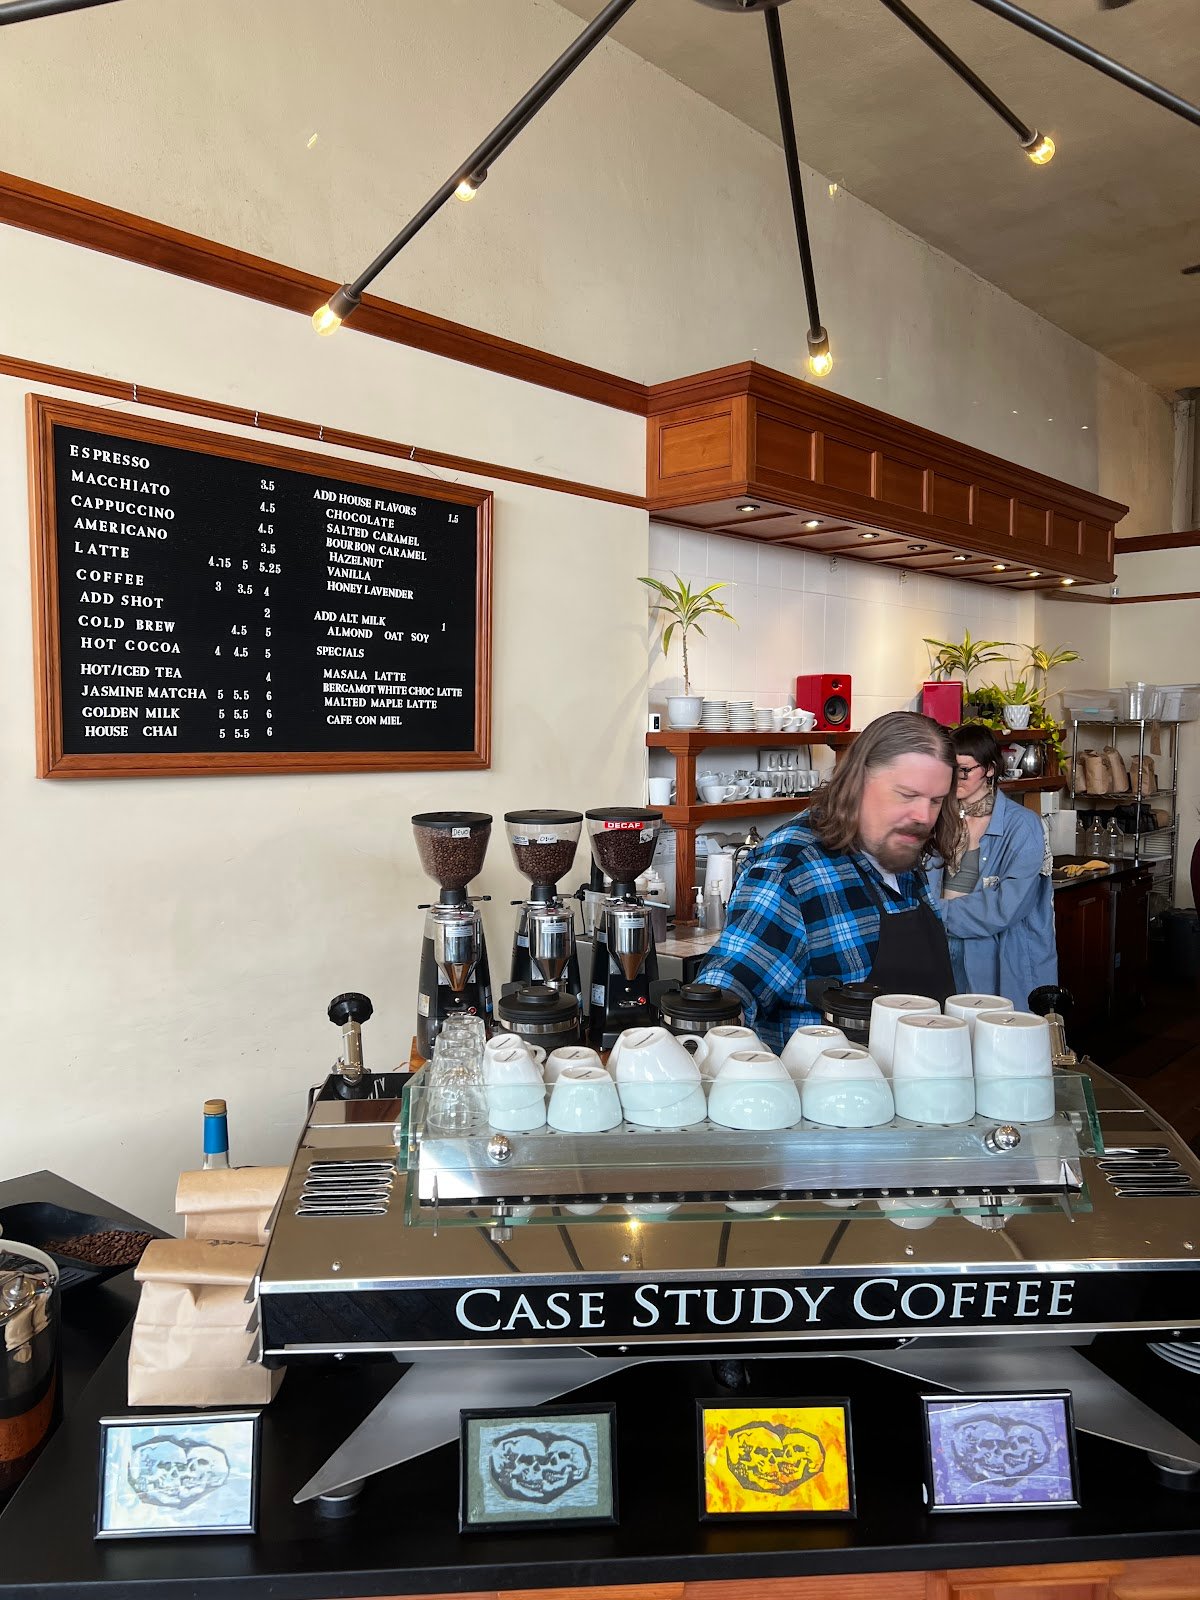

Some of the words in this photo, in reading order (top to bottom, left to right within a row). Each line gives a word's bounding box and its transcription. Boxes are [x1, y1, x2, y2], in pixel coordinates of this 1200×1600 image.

[69, 444, 150, 470] ESPRESSO
[260, 479, 275, 492] 3.5
[71, 469, 171, 497] MACCHIATO
[259, 501, 276, 514] 4.5
[70, 494, 175, 520] CAPPUCCINO
[257, 522, 274, 535] 4.5
[312, 488, 338, 502] ADD
[338, 492, 372, 509] HOUSE
[374, 499, 417, 517] FLAVORS
[447, 513, 459, 524] 1.5
[325, 508, 395, 529] CHOCOLATE
[73, 517, 168, 540] AMERICANO
[260, 542, 277, 555] 3.5
[326, 523, 369, 539] SALTED
[372, 530, 420, 547] CARAMEL
[74, 540, 130, 559] LATTE
[242, 559, 249, 571] 5
[258, 561, 282, 575] 5.25
[325, 536, 376, 554] BOURBON
[378, 545, 428, 561] CARAMEL
[328, 551, 385, 569] HAZELNUT
[75, 568, 144, 587] COFFEE
[214, 580, 222, 592] 3
[237, 583, 253, 595] 3.5
[263, 586, 270, 597] 4
[326, 565, 372, 582] VANILLA
[326, 580, 363, 595] HONEY
[363, 584, 414, 600] LAVENDER
[79, 590, 115, 605] ADD
[120, 594, 164, 609] SHOT
[263, 607, 271, 619] 2
[77, 614, 125, 629] COLD
[135, 618, 176, 633] BREW
[230, 624, 248, 636] 4.5
[265, 627, 272, 638] 5
[313, 610, 338, 622] ADD
[361, 614, 387, 627] MILK
[441, 622, 446, 632] 1
[326, 625, 374, 639] ALMOND
[383, 630, 405, 642] OAT
[410, 632, 430, 644] SOY
[80, 636, 117, 650] HOT
[124, 639, 181, 654] COCOA
[214, 645, 222, 656] 4
[233, 646, 249, 658] 4.5
[264, 648, 272, 659] 5
[316, 645, 365, 659] SPECIALS
[80, 663, 150, 678] HOT/ICED
[154, 666, 183, 679] TEA
[265, 671, 272, 683] 4
[323, 668, 368, 681] MASALA
[374, 670, 407, 682] LATTE
[80, 684, 144, 698] JASMINE
[147, 686, 208, 700] MATCHA
[217, 689, 224, 700] 5
[233, 689, 250, 701] 5.5
[265, 690, 273, 701] 6
[322, 682, 377, 695] BERGAMOT
[376, 684, 408, 697] WHITE
[407, 686, 435, 697] CHOC
[436, 687, 463, 698] LATTE
[81, 706, 139, 719] GOLDEN
[145, 707, 181, 719] MILK
[218, 708, 226, 720] 5
[233, 708, 249, 720] 5.5
[265, 708, 273, 719] 6
[324, 696, 367, 708] MALTED
[370, 697, 404, 709] MAPLE
[406, 698, 438, 710] LATTE
[326, 714, 353, 726] CAFE
[354, 715, 377, 726] CON
[379, 715, 403, 726] MIEL
[84, 725, 129, 737] HOUSE
[142, 725, 178, 737] CHAI
[219, 728, 226, 739] 5
[234, 728, 250, 739] 5.5
[266, 726, 273, 737] 6
